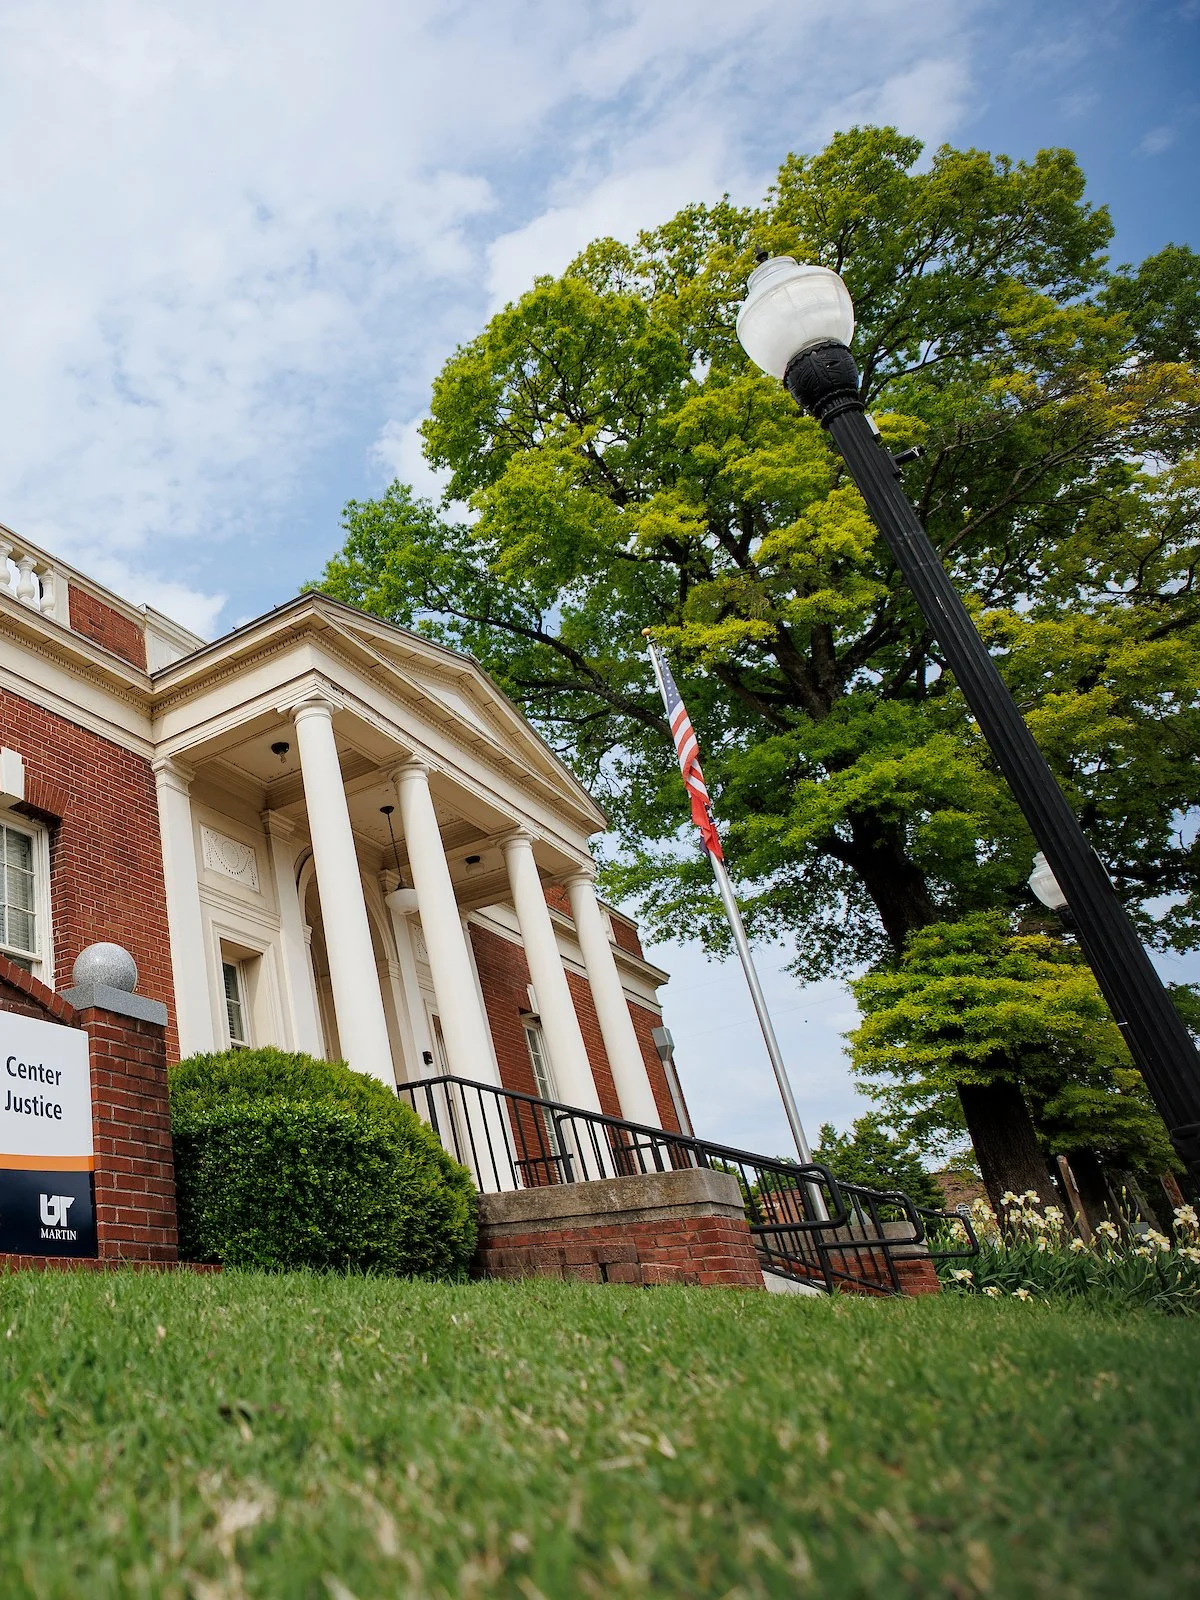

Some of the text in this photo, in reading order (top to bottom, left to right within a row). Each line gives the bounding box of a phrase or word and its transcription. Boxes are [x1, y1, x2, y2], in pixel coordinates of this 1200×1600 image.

[6, 1056, 62, 1086] Center
[4, 1089, 63, 1121] Justice
[39, 1193, 76, 1228] UT
[40, 1228, 77, 1241] MARTIN
